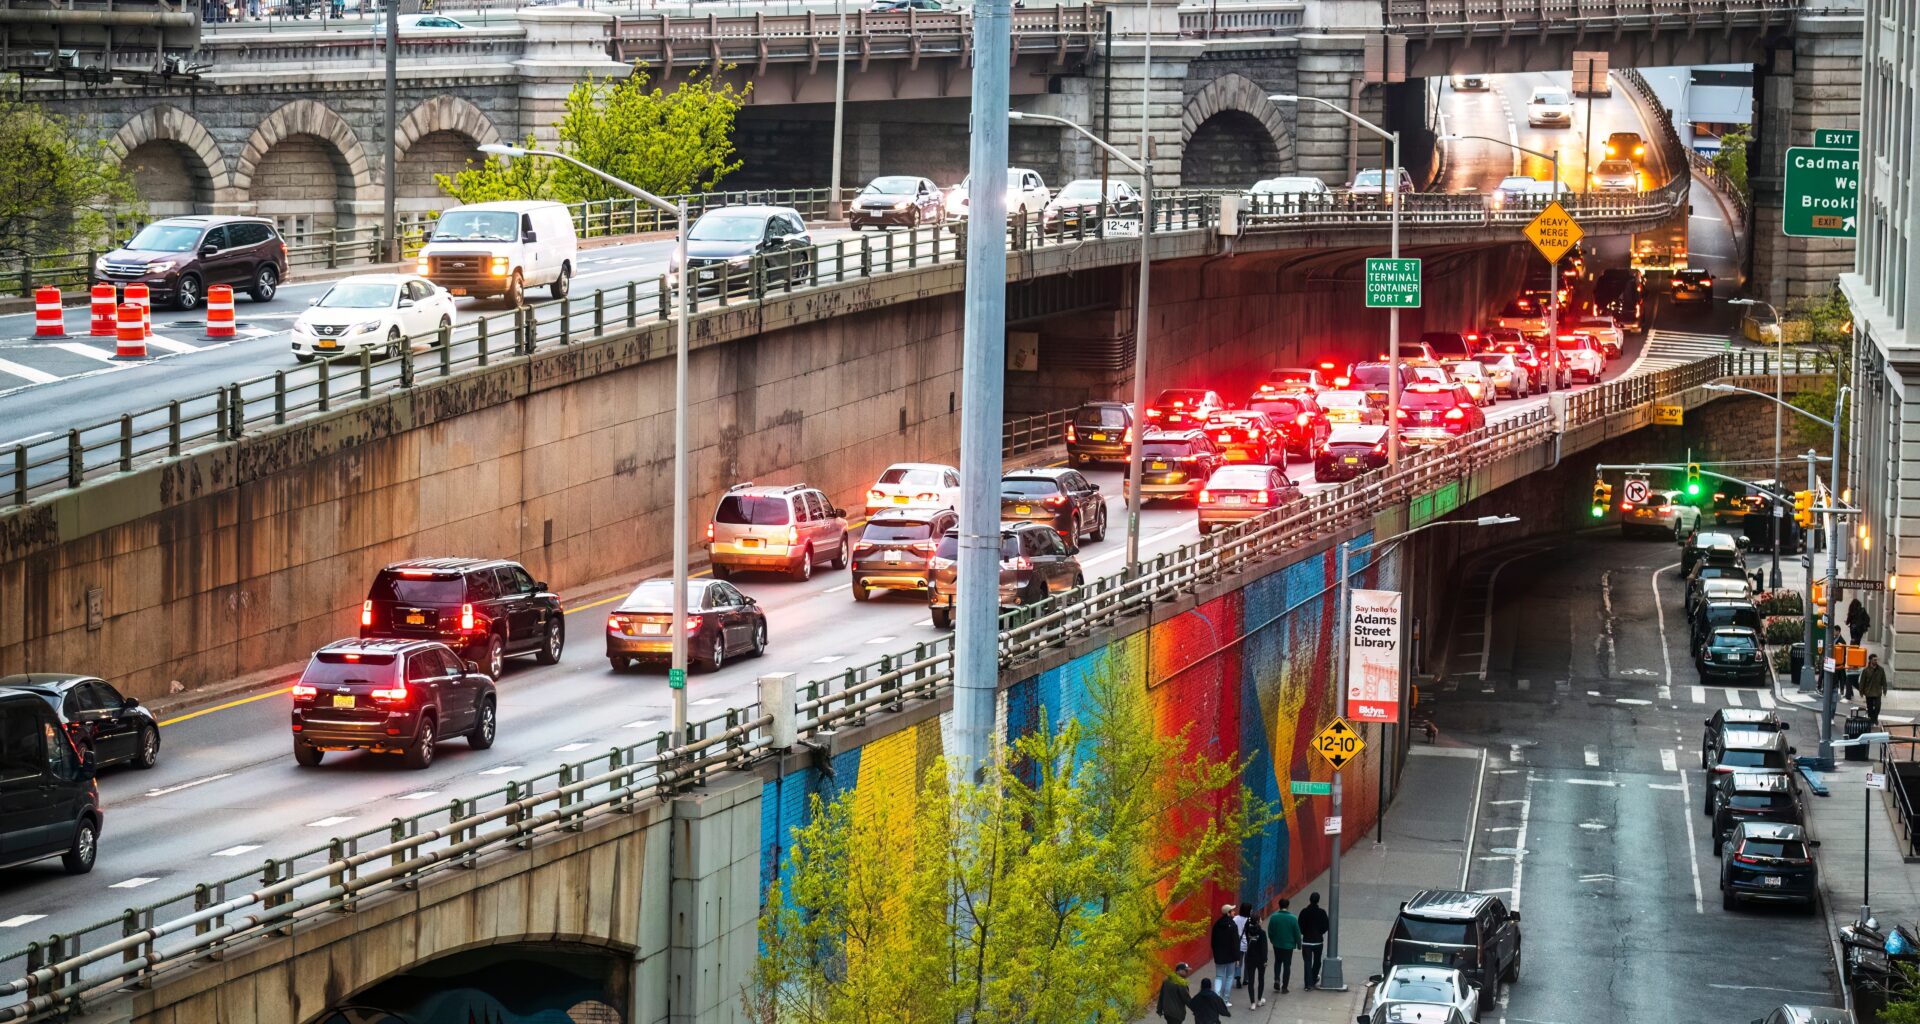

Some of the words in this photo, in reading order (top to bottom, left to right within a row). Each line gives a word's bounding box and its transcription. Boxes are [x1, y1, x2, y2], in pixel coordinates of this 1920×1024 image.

[1825, 134, 1853, 144] EXIT
[1700, 149, 1721, 160] PAR
[1795, 156, 1860, 170] Cadman
[1802, 195, 1860, 209] Brookl
[1107, 220, 1135, 230] 12'-4"
[1540, 218, 1569, 226] HEAVY
[1818, 218, 1836, 226] EXIT
[1540, 228, 1569, 237] MERGE
[1540, 239, 1569, 247] AHEAD
[1371, 262, 1398, 271] KANE
[1404, 262, 1416, 271] ST
[1369, 273, 1418, 282] TERMINAL
[1368, 283, 1418, 292] CONTAINER
[1373, 294, 1399, 303] PORT
[1838, 580, 1874, 589] Washington
[1355, 605, 1369, 613] Say
[1354, 613, 1397, 625] Adams
[1354, 625, 1391, 636] Street
[1354, 637, 1396, 650] Library
[1319, 736, 1358, 752] 12'-10"
